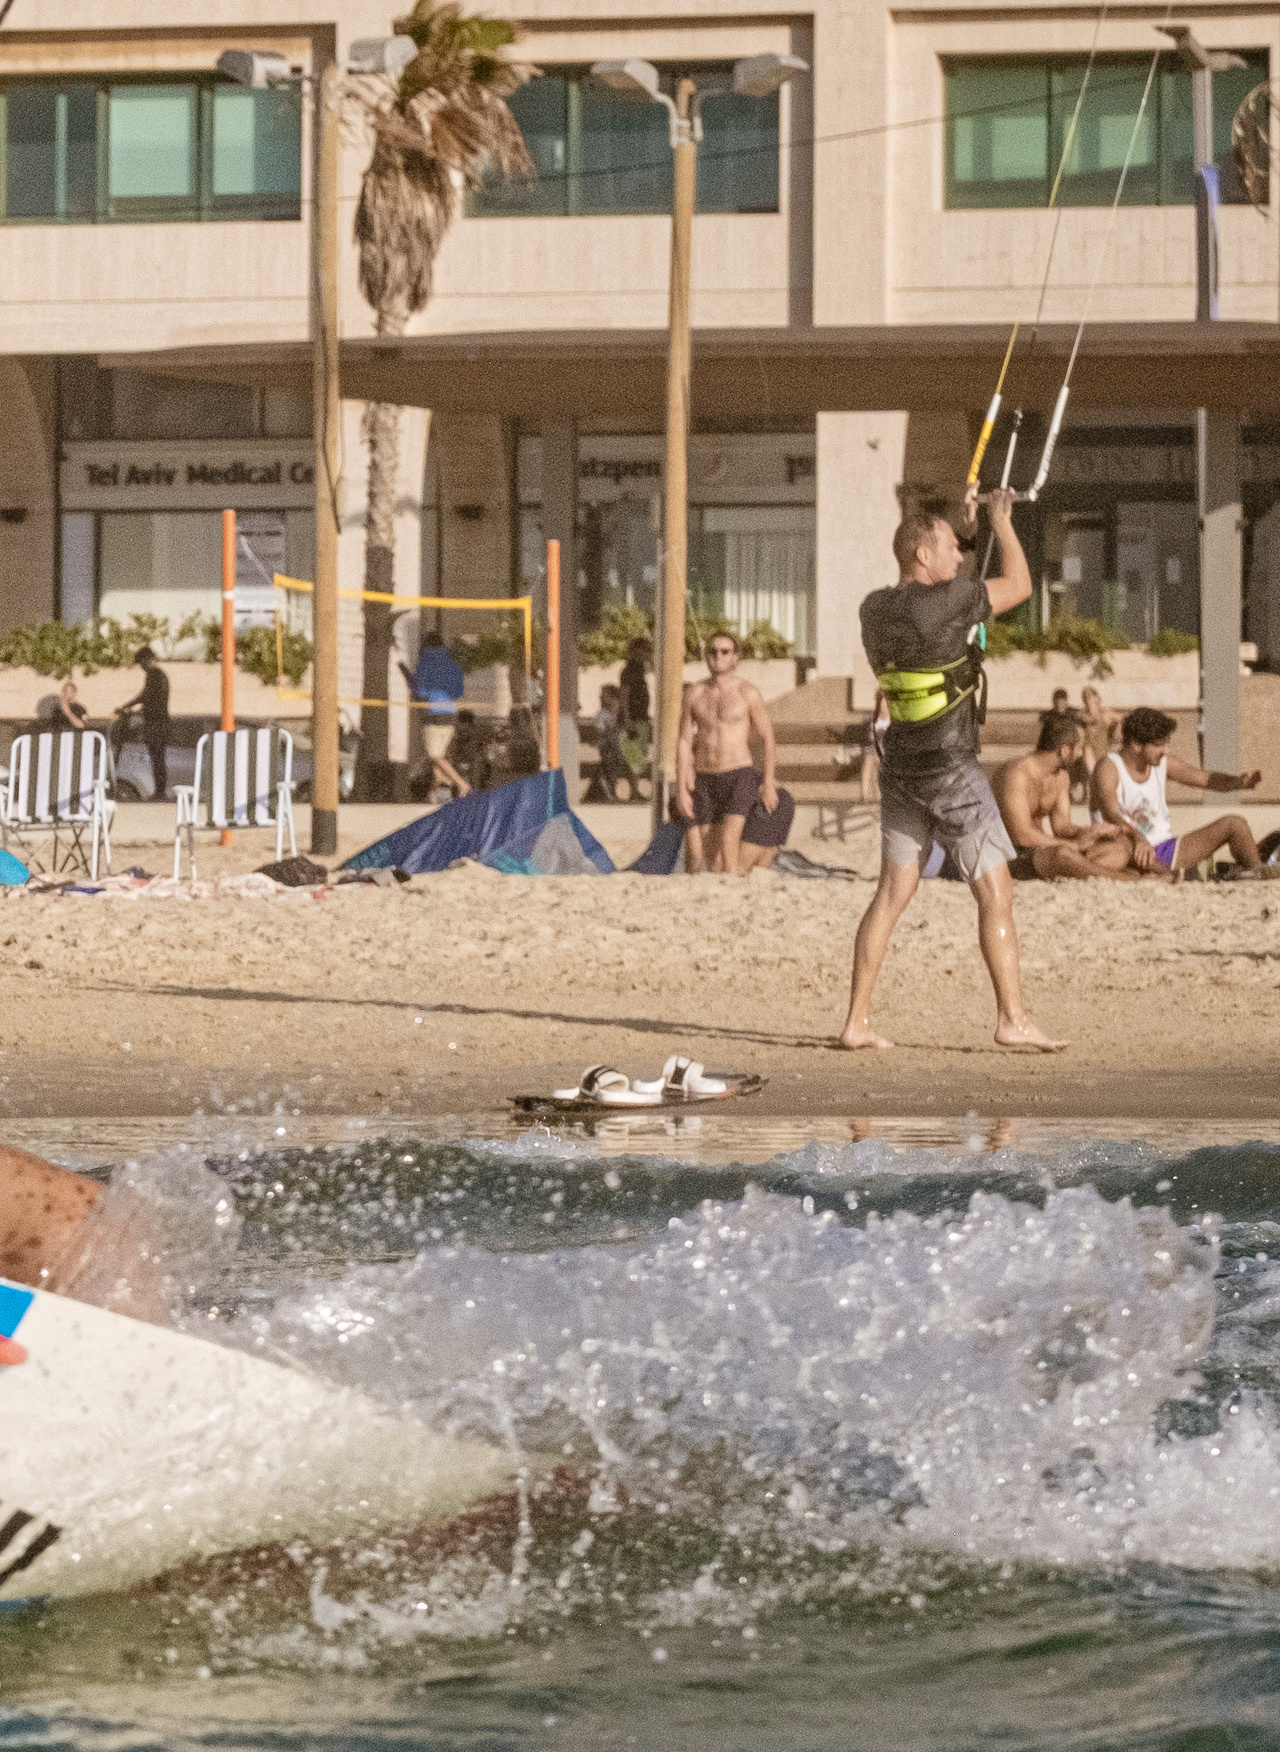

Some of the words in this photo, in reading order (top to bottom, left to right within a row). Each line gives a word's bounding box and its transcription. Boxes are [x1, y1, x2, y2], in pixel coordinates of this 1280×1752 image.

[86, 463, 118, 486] Tel
[125, 463, 177, 486] Aviv
[186, 461, 282, 485] Medical
